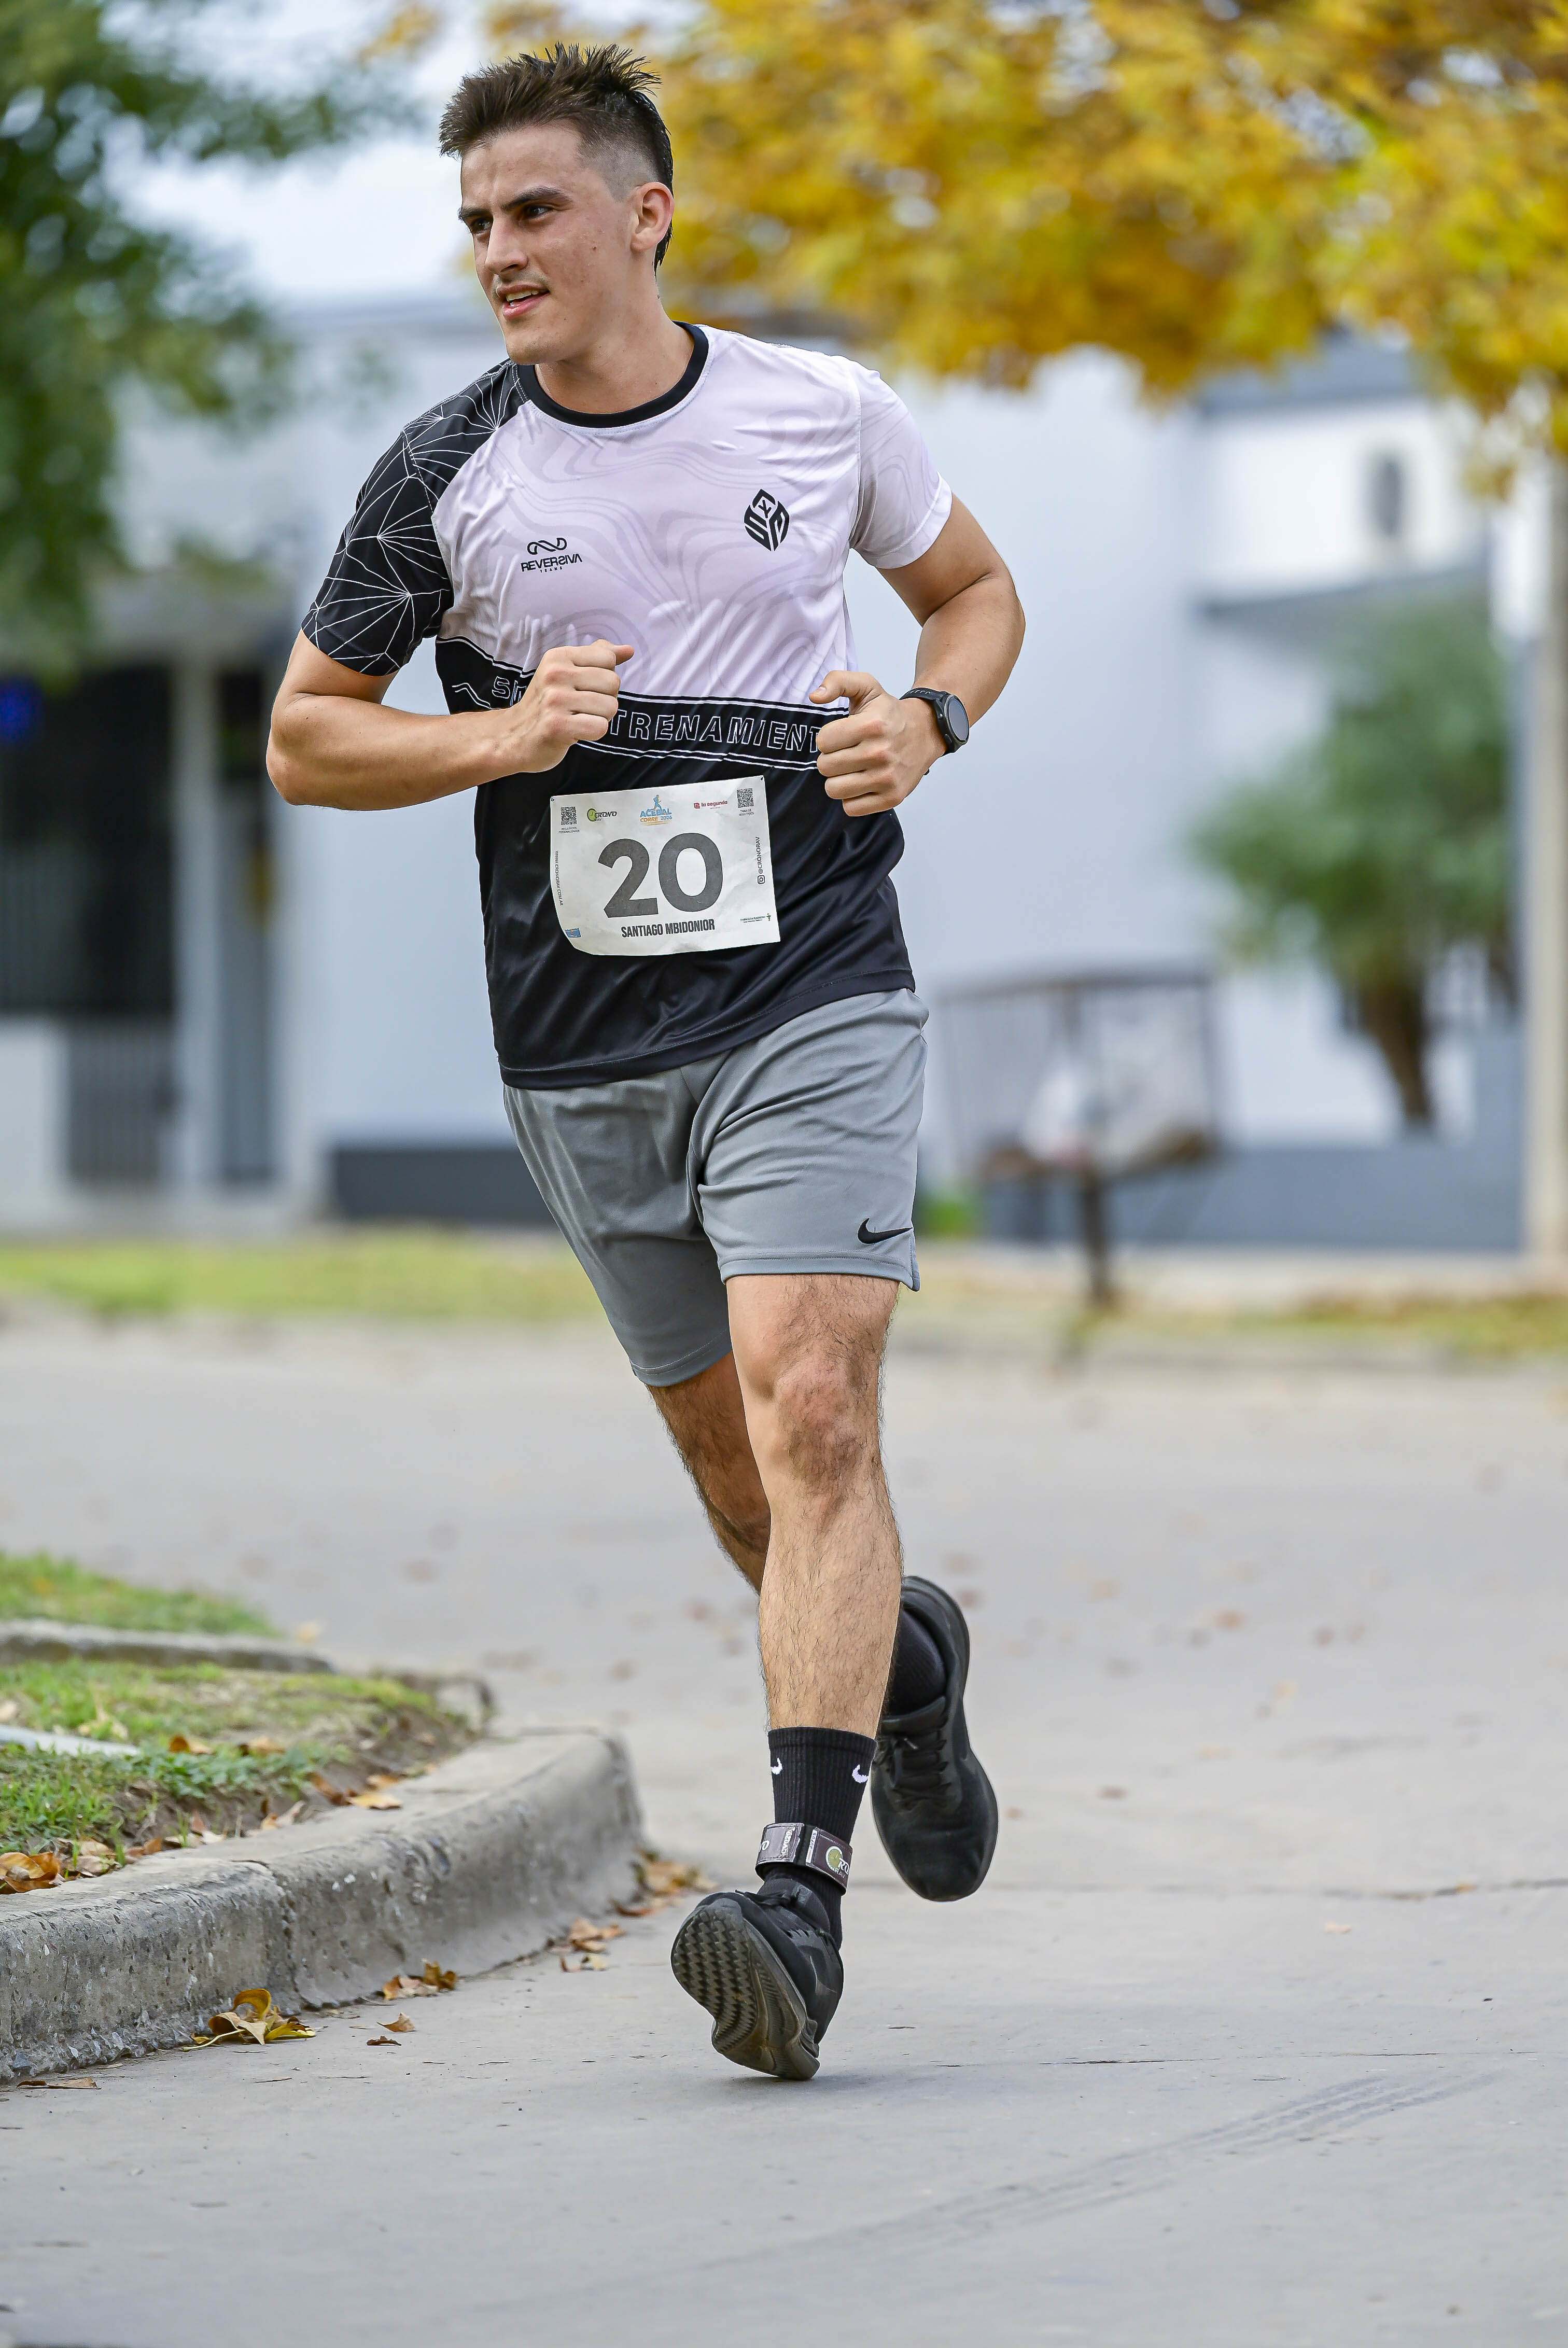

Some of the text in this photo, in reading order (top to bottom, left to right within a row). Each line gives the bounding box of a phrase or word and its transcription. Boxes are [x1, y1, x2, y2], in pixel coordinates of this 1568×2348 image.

[610, 709, 822, 753] TRENAMIENT
[598, 833, 723, 918] 20
[755, 836, 763, 874] @CRONORAV
[621, 918, 715, 938] SANTIAGO MBIDONIOR
